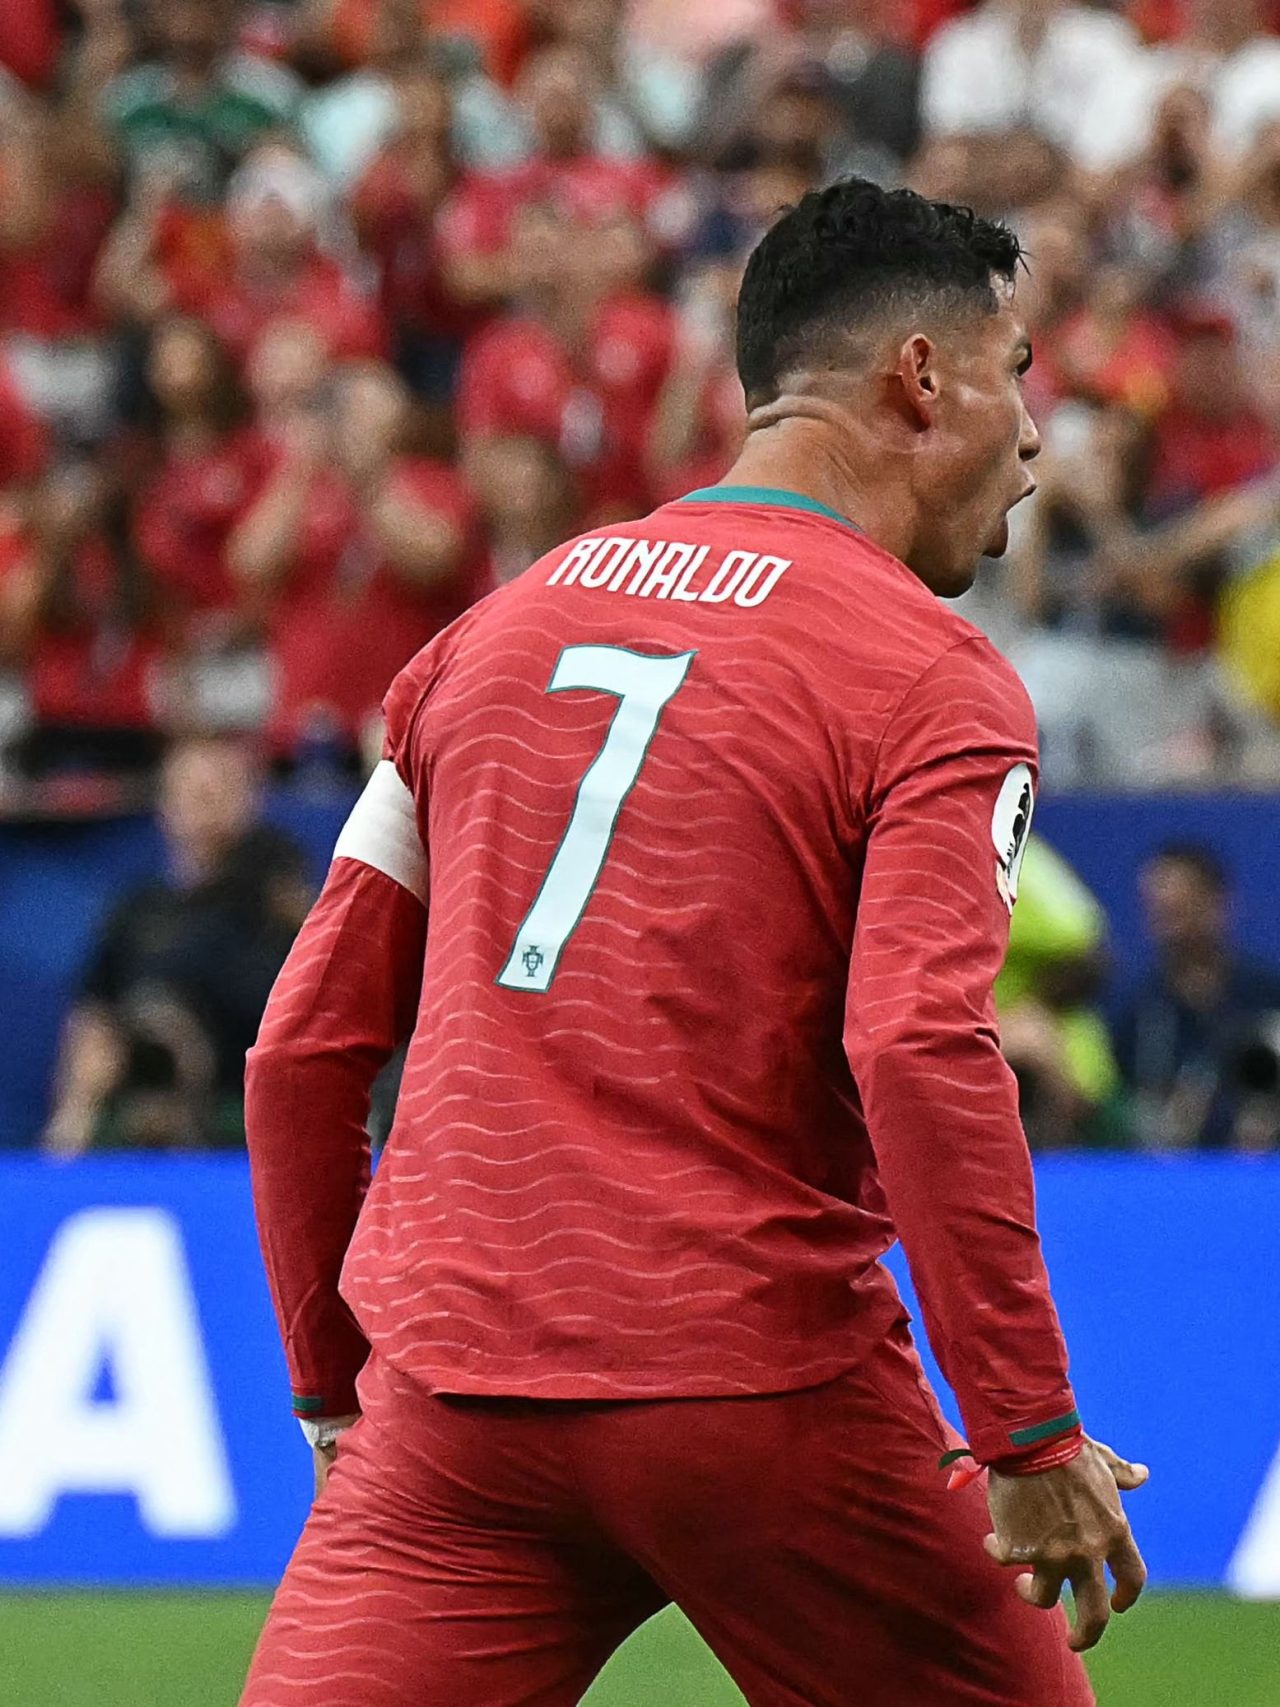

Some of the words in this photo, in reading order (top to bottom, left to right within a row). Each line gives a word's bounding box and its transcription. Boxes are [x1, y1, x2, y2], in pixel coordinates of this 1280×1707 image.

[545, 537, 793, 608] RONALDO
[494, 643, 699, 993] 7
[0, 1207, 238, 1540] A
